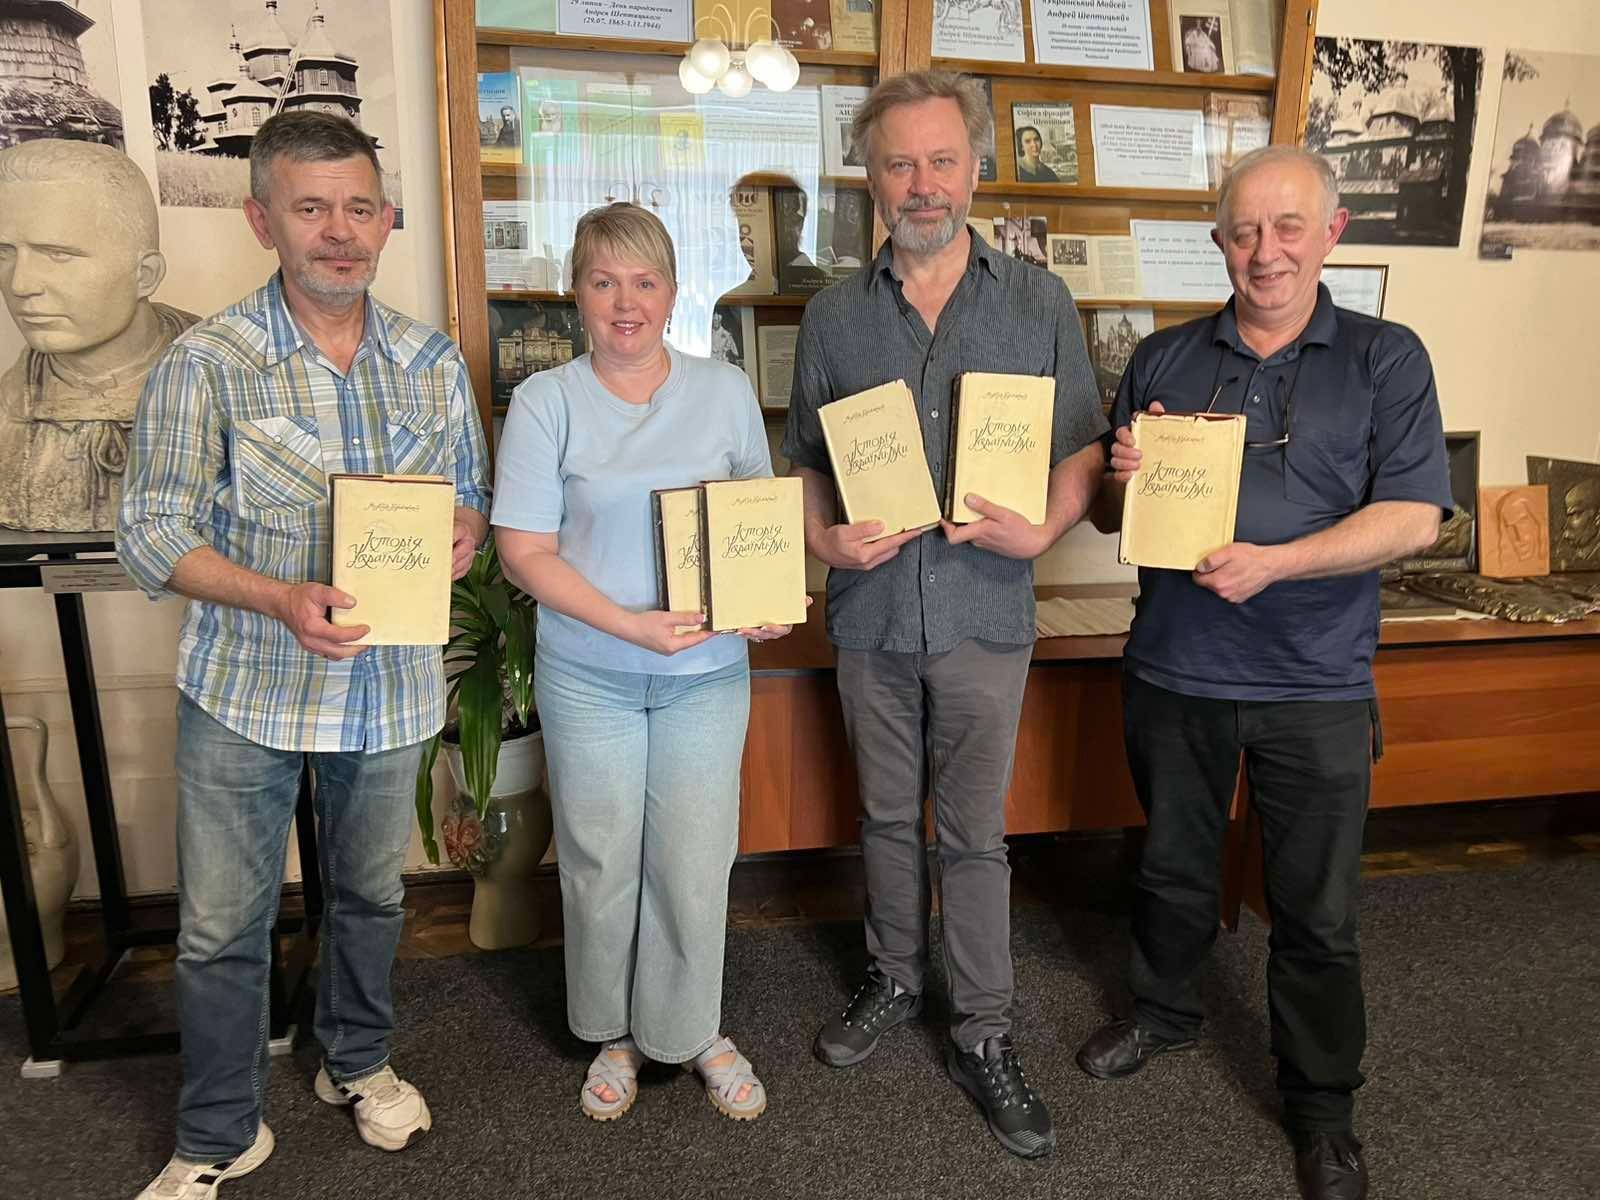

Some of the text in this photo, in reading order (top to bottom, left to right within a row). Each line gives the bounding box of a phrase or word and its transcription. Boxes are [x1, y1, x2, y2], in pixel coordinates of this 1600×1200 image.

[1047, 9, 1076, 19] Андрей
[980, 416, 1031, 439] Історія
[851, 432, 897, 459] Історія
[1151, 459, 1207, 482] Історія
[361, 529, 423, 553] Історія
[734, 521, 783, 542] Історія
